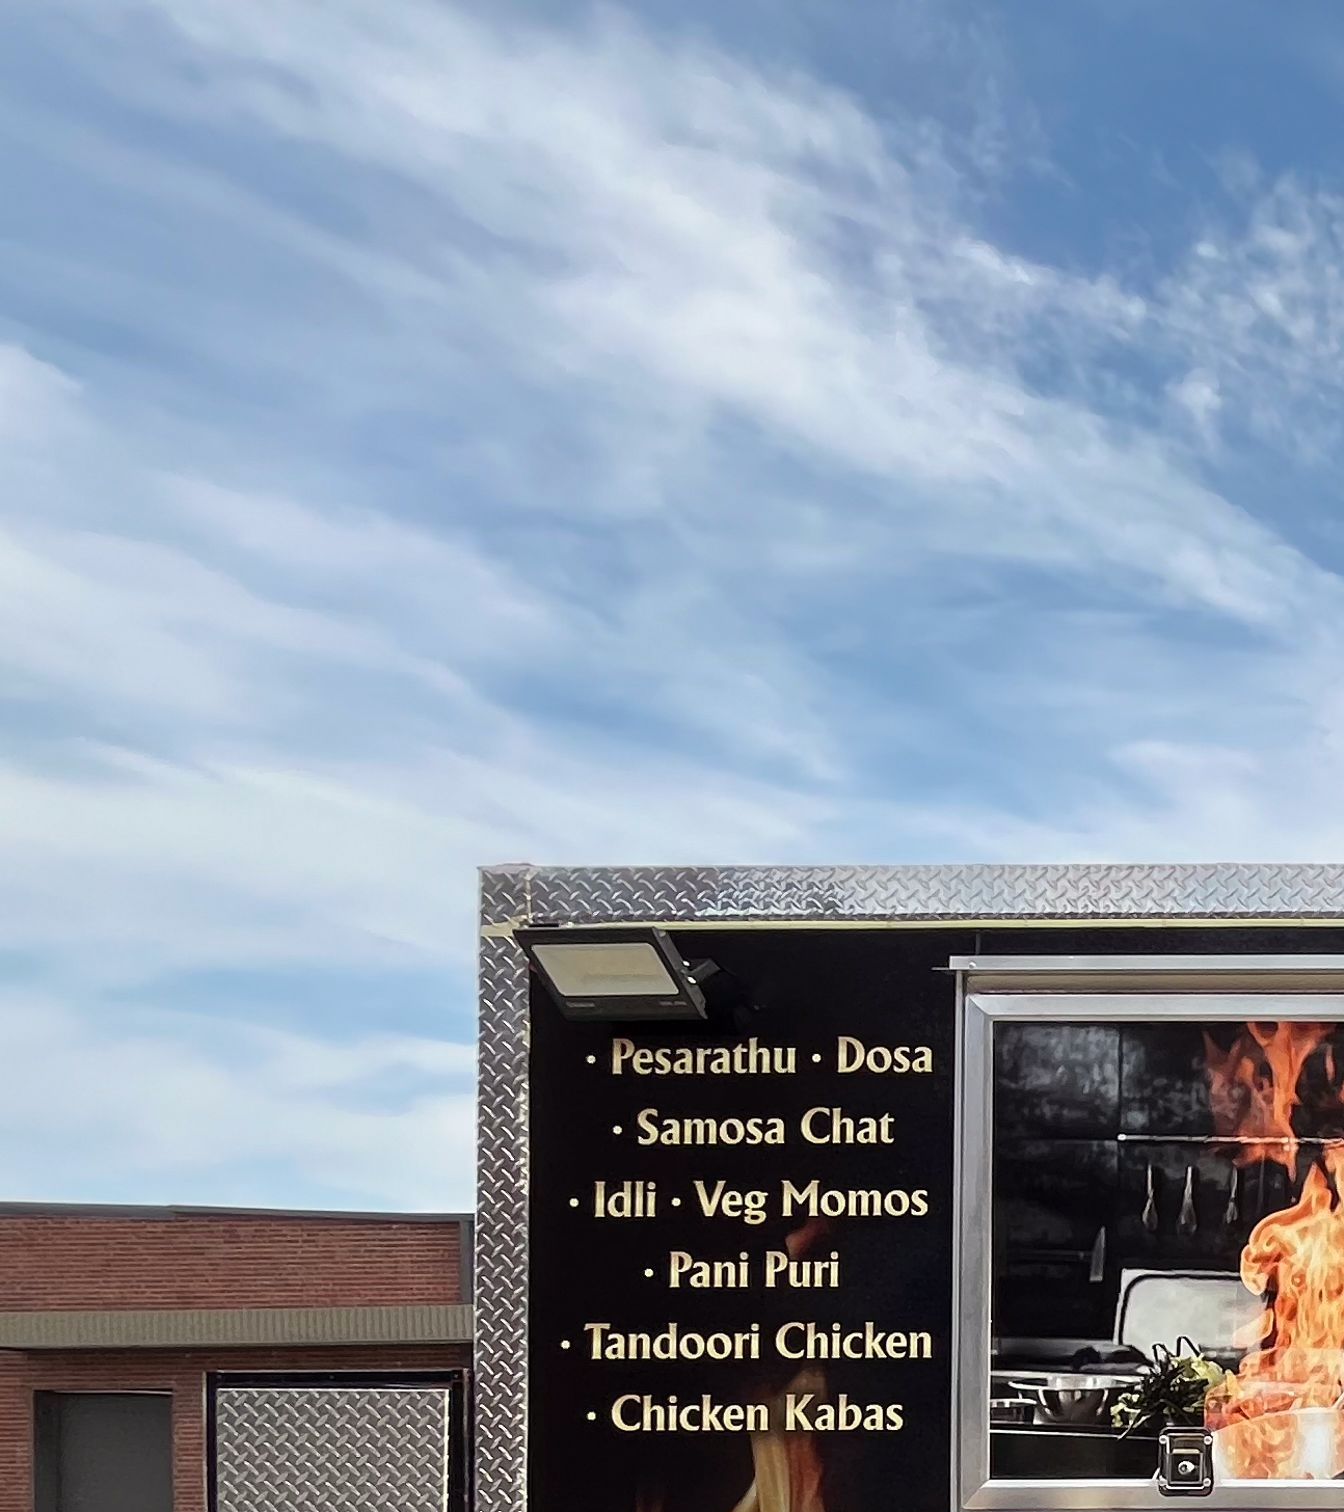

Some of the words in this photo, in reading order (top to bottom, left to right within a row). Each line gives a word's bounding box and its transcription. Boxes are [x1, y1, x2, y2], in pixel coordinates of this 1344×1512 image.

[612, 1037, 797, 1075] Pesarathu
[837, 1036, 933, 1073] Dosa
[636, 1108, 786, 1145] Samosa
[800, 1107, 895, 1144] Chat
[593, 1180, 657, 1218] Idli
[694, 1180, 768, 1225] Veg
[781, 1179, 929, 1217] Momos
[669, 1251, 749, 1288] Pani
[765, 1250, 839, 1288] Puri
[583, 1322, 761, 1360] Tandoori
[775, 1321, 932, 1359] Chicken
[611, 1394, 769, 1432] Chicken
[785, 1393, 905, 1431] Kabas
